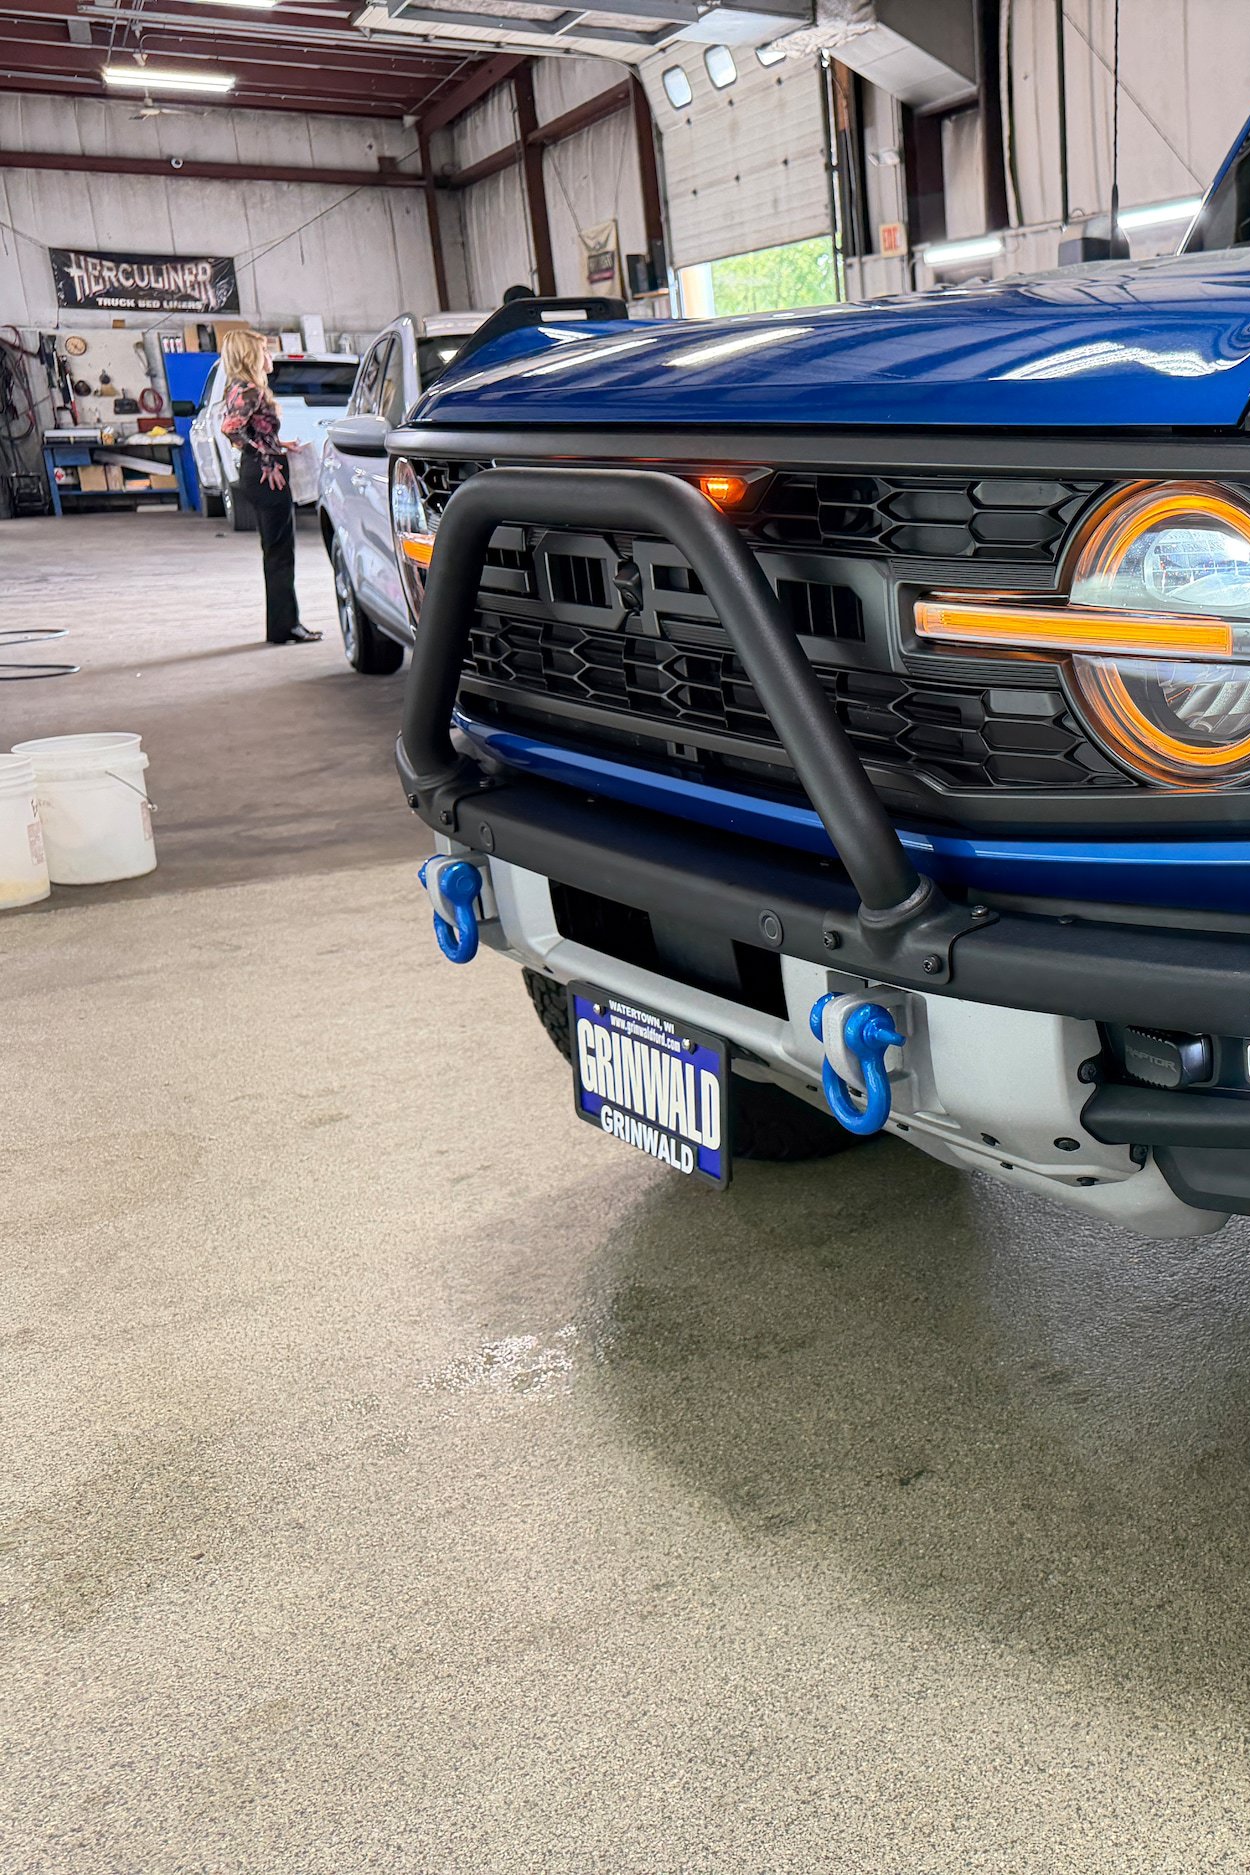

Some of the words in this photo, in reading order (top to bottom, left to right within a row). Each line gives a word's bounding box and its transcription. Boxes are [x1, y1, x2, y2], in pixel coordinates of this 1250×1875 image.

[64, 252, 217, 308] HERCULINER
[96, 296, 136, 308] TRUCK
[138, 299, 161, 309] BED
[608, 999, 663, 1032] WATERTOWN,
[663, 1020, 675, 1035] WI
[1125, 1045, 1178, 1074] RAPTOR
[576, 1017, 721, 1151] GRINWALD
[600, 1103, 695, 1175] GRINWALD
